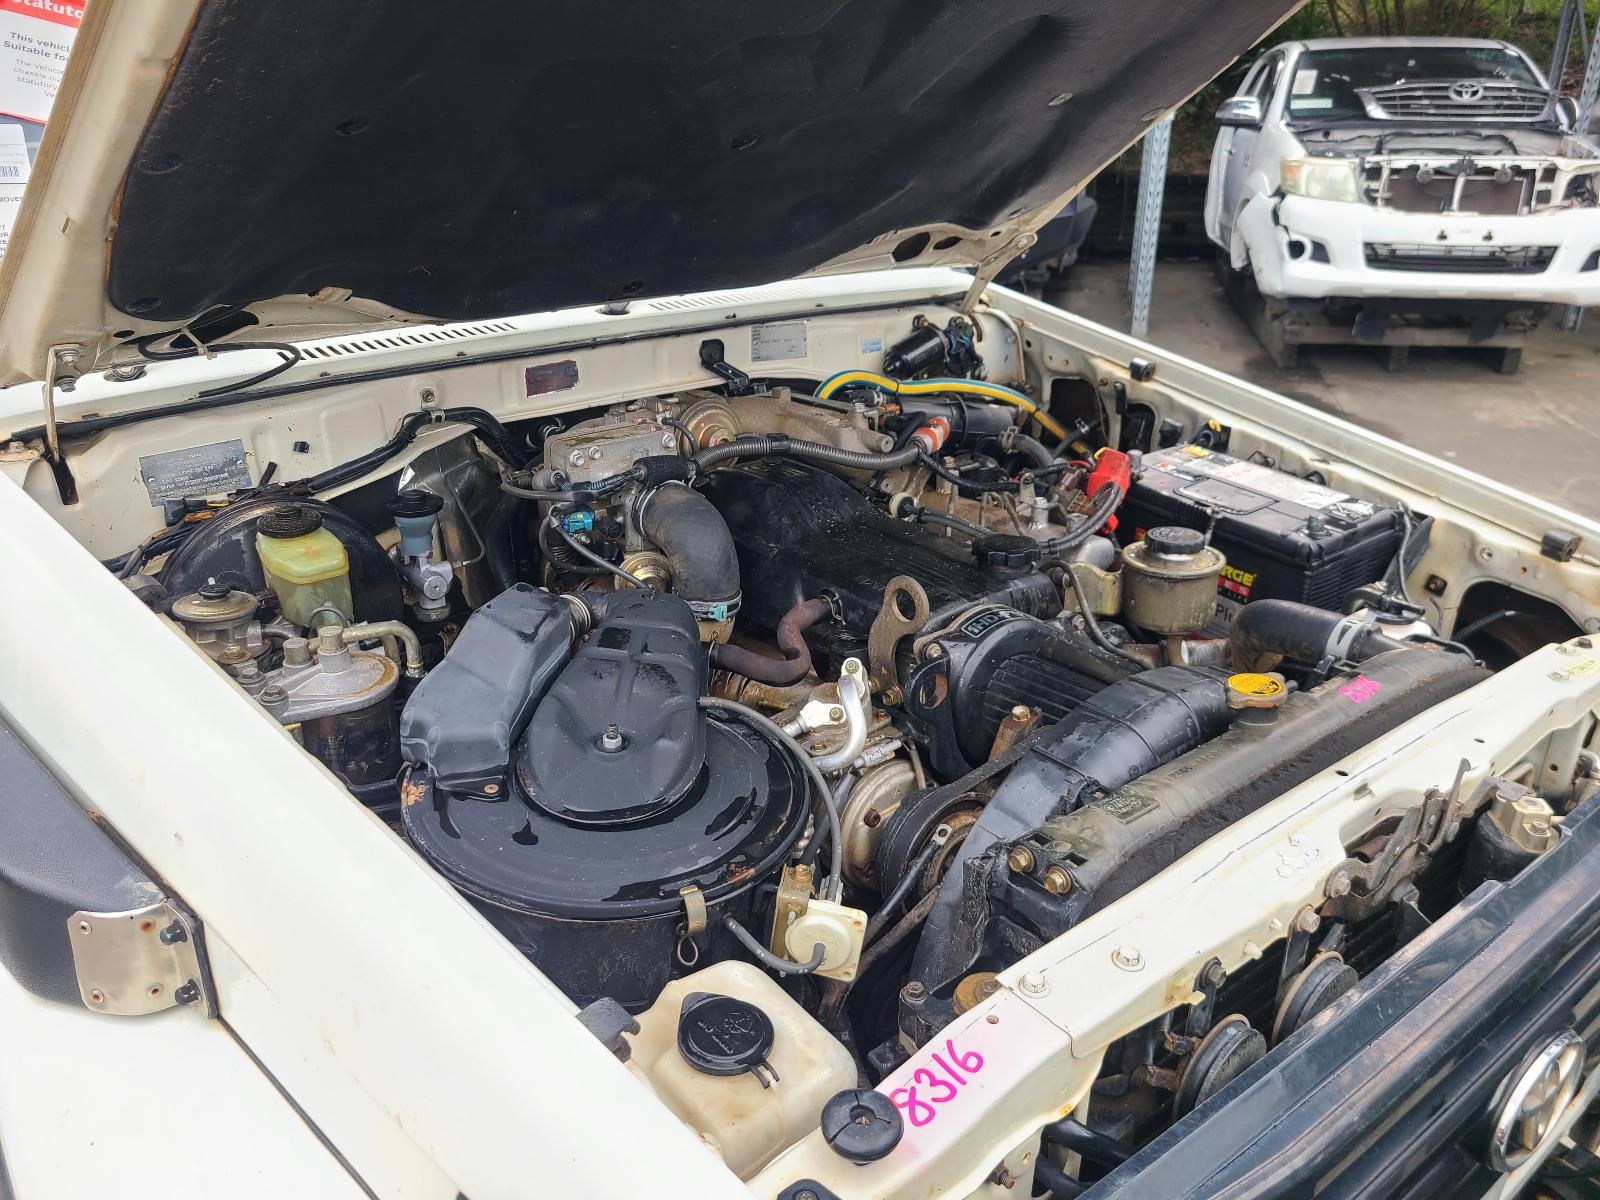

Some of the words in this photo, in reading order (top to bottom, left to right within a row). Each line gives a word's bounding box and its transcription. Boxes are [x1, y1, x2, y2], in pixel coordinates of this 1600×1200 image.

[12, 0, 84, 19] tatuto
[10, 31, 34, 44] This
[3, 40, 51, 58] Suitable
[889, 1039, 984, 1127] 8316
